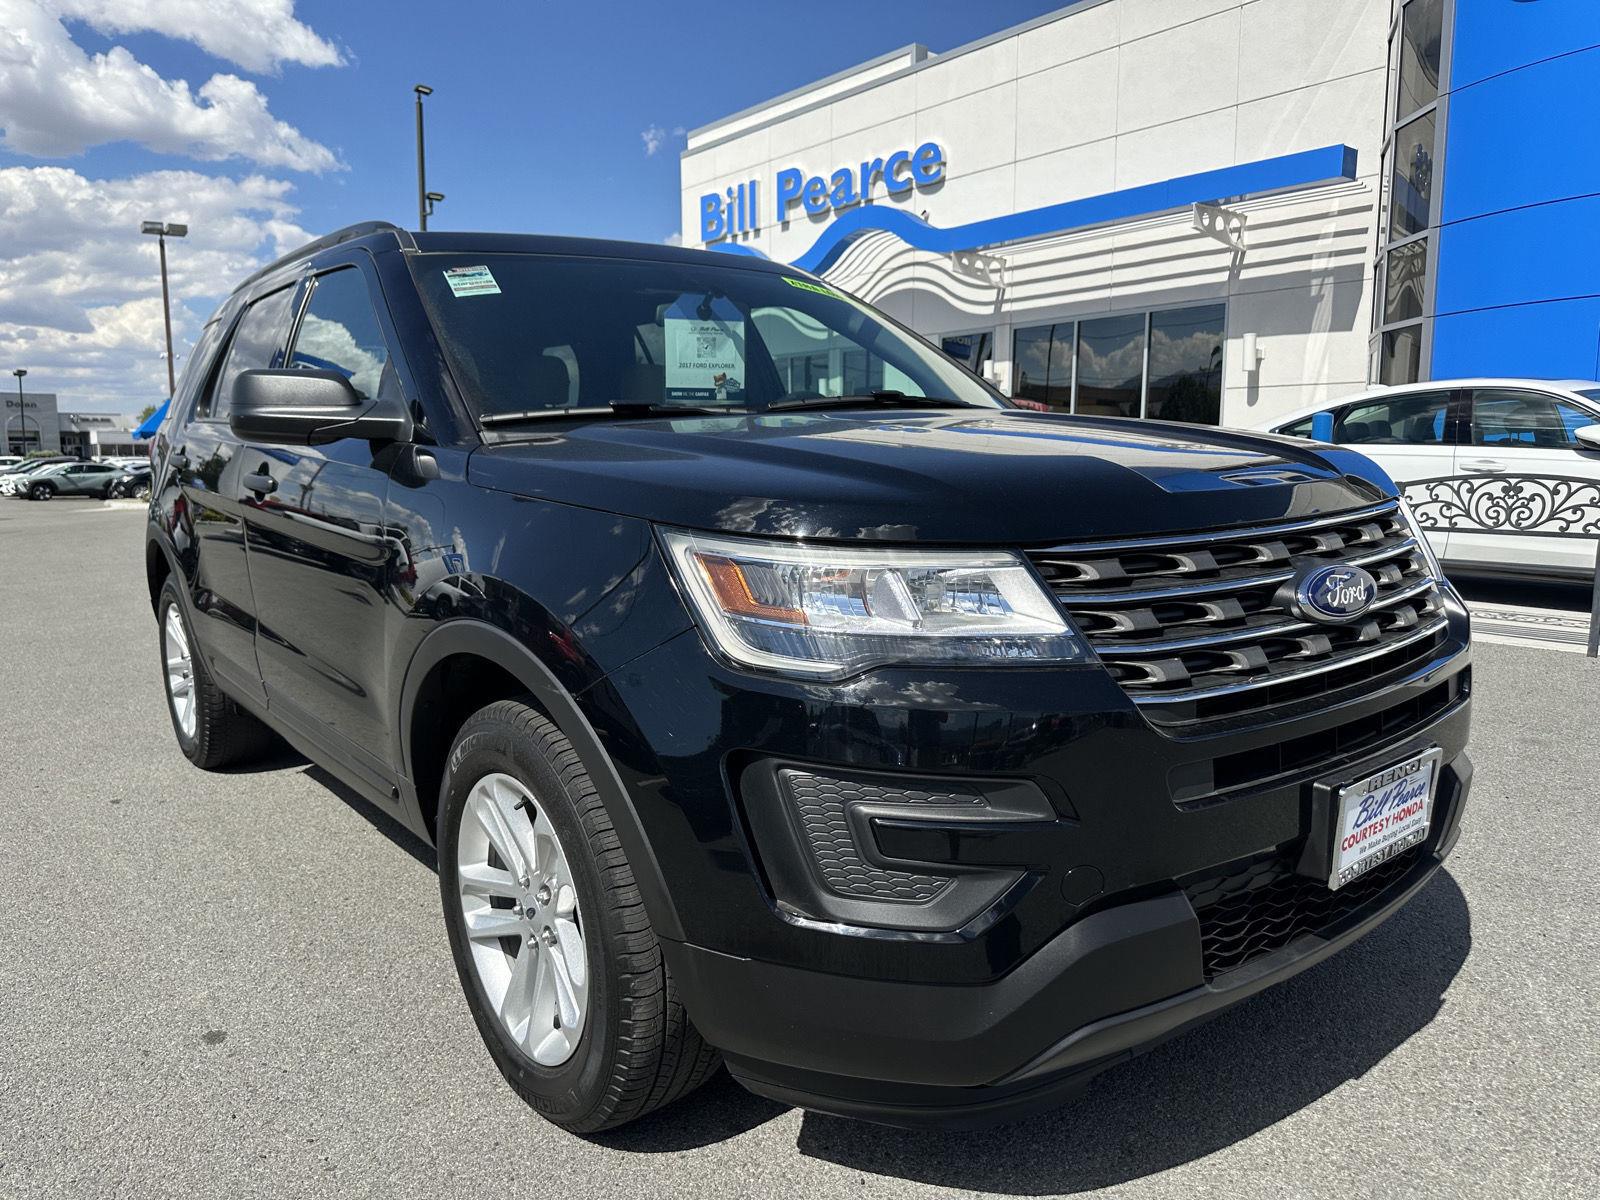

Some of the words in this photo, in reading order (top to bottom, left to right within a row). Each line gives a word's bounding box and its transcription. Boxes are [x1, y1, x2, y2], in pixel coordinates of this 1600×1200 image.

[700, 179, 757, 242] Bill
[776, 142, 942, 222] Pearce
[6, 400, 37, 409] Doan
[1325, 573, 1368, 608] Ford
[1368, 759, 1419, 792] RENO
[1352, 788, 1394, 830] Bill
[1388, 778, 1426, 811] Pearce
[1340, 815, 1391, 852] COURTESY
[1391, 798, 1424, 826] HONDA
[1368, 839, 1381, 849] Make
